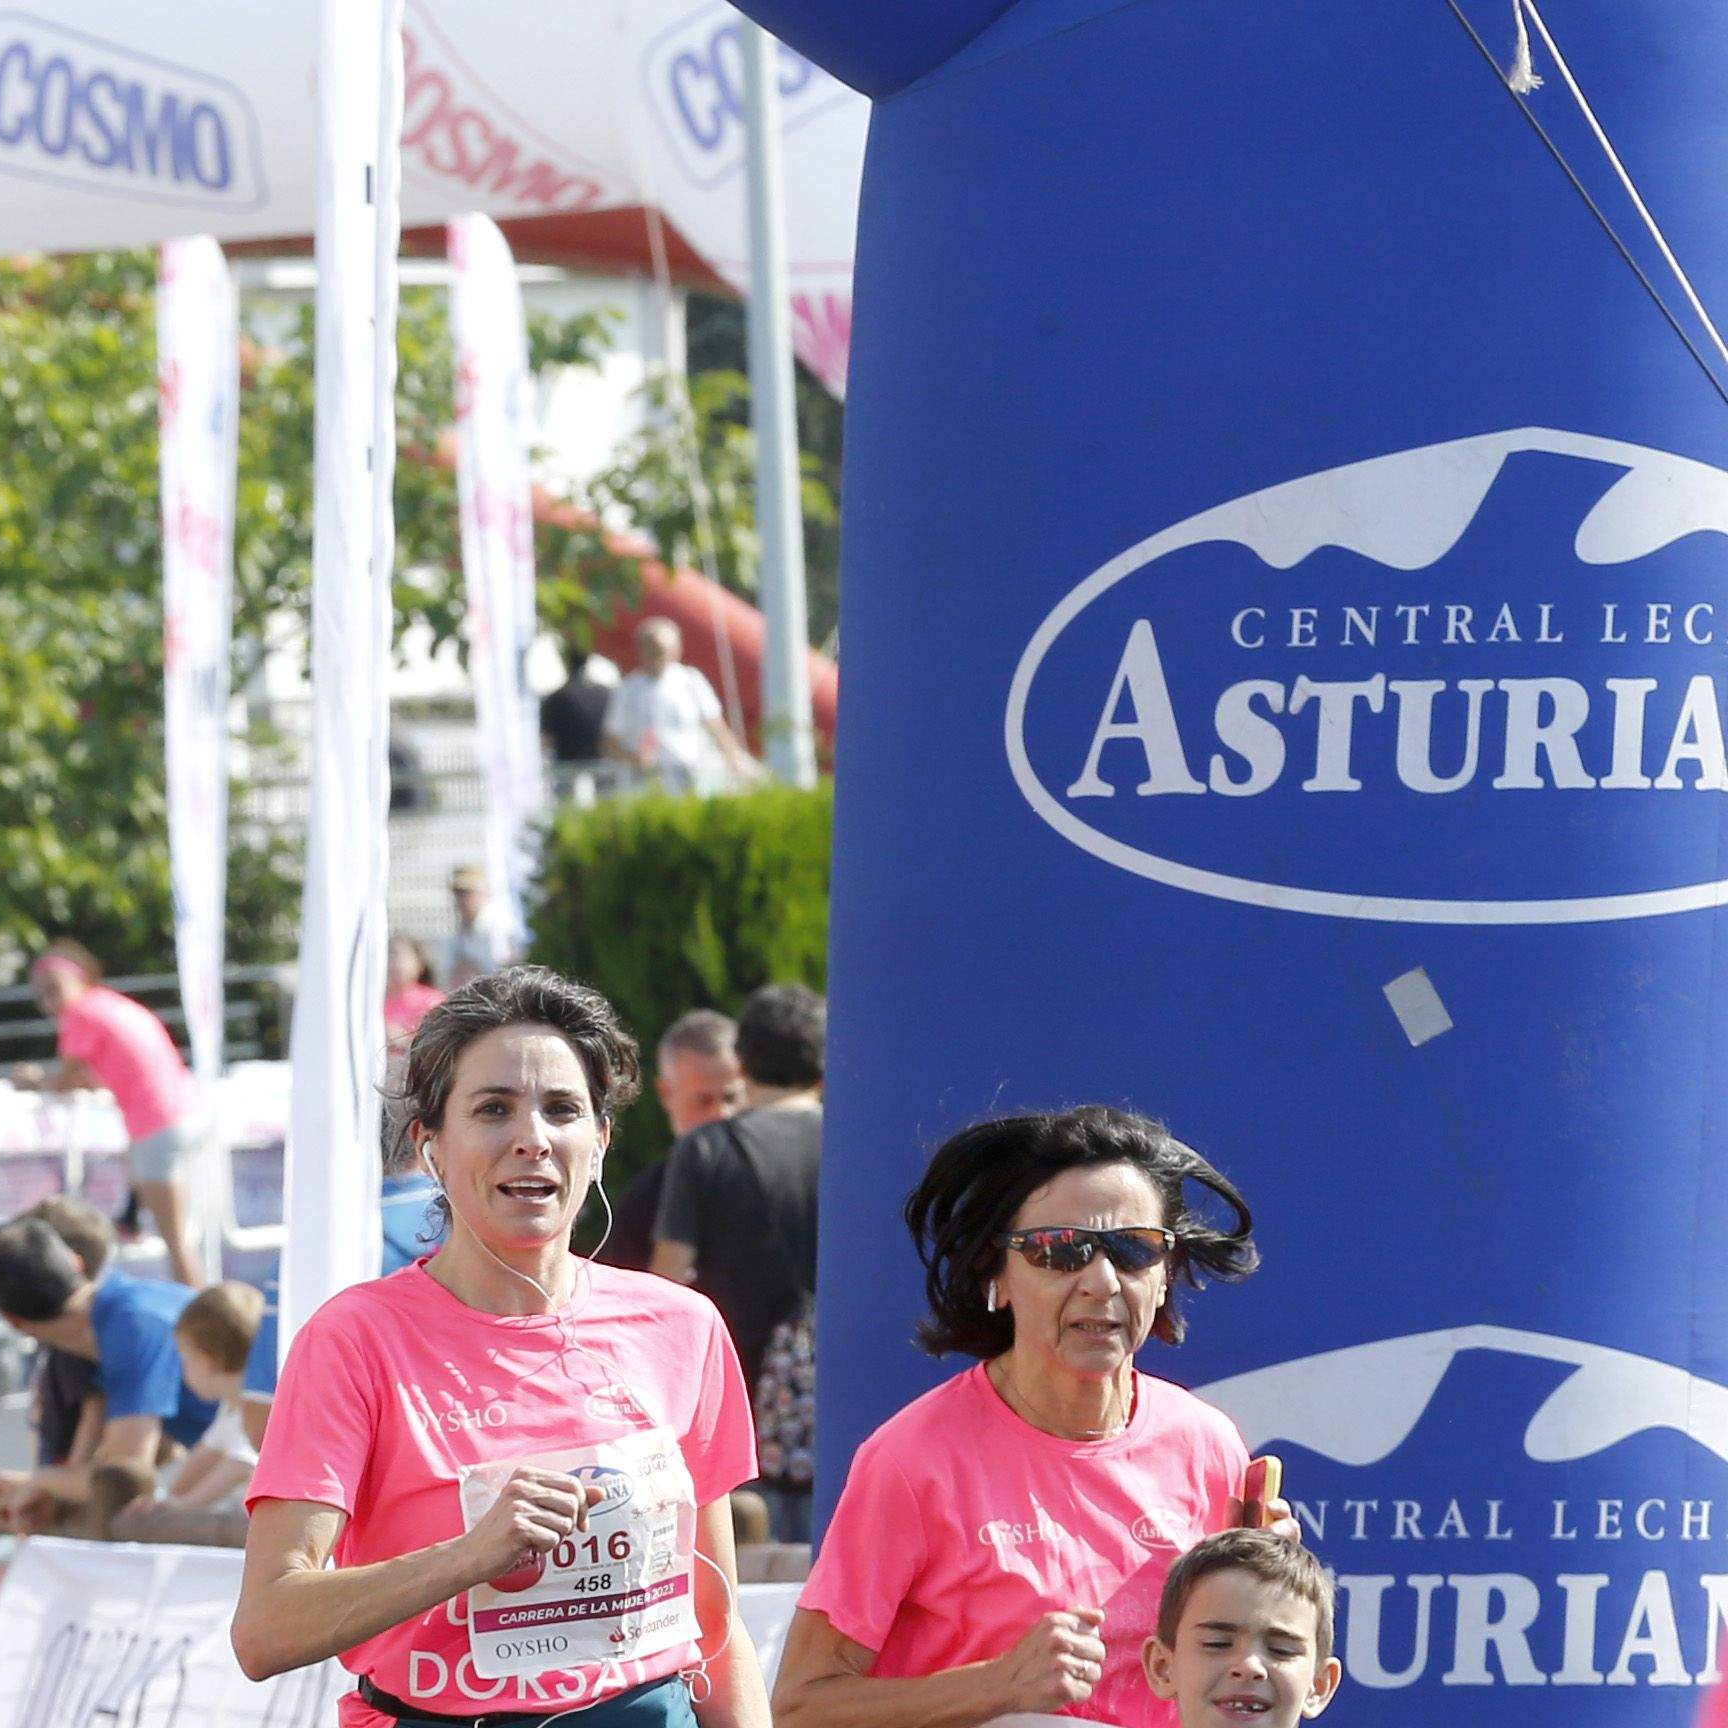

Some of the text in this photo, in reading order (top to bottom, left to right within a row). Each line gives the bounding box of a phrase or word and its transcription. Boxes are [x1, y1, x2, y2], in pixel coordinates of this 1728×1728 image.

[1230, 603, 1716, 648] CENTRAL LEC
[1066, 618, 1728, 798] ASTURIA
[1296, 1498, 1714, 1541] NTRAL LECH
[552, 1530, 631, 1568] 016
[574, 1574, 612, 1593] 458
[498, 1606, 565, 1625] CARRERA
[567, 1604, 587, 1616] DE
[590, 1601, 610, 1614] LA
[1330, 1569, 1728, 1690] URIA
[495, 1635, 568, 1659] OYSHO
